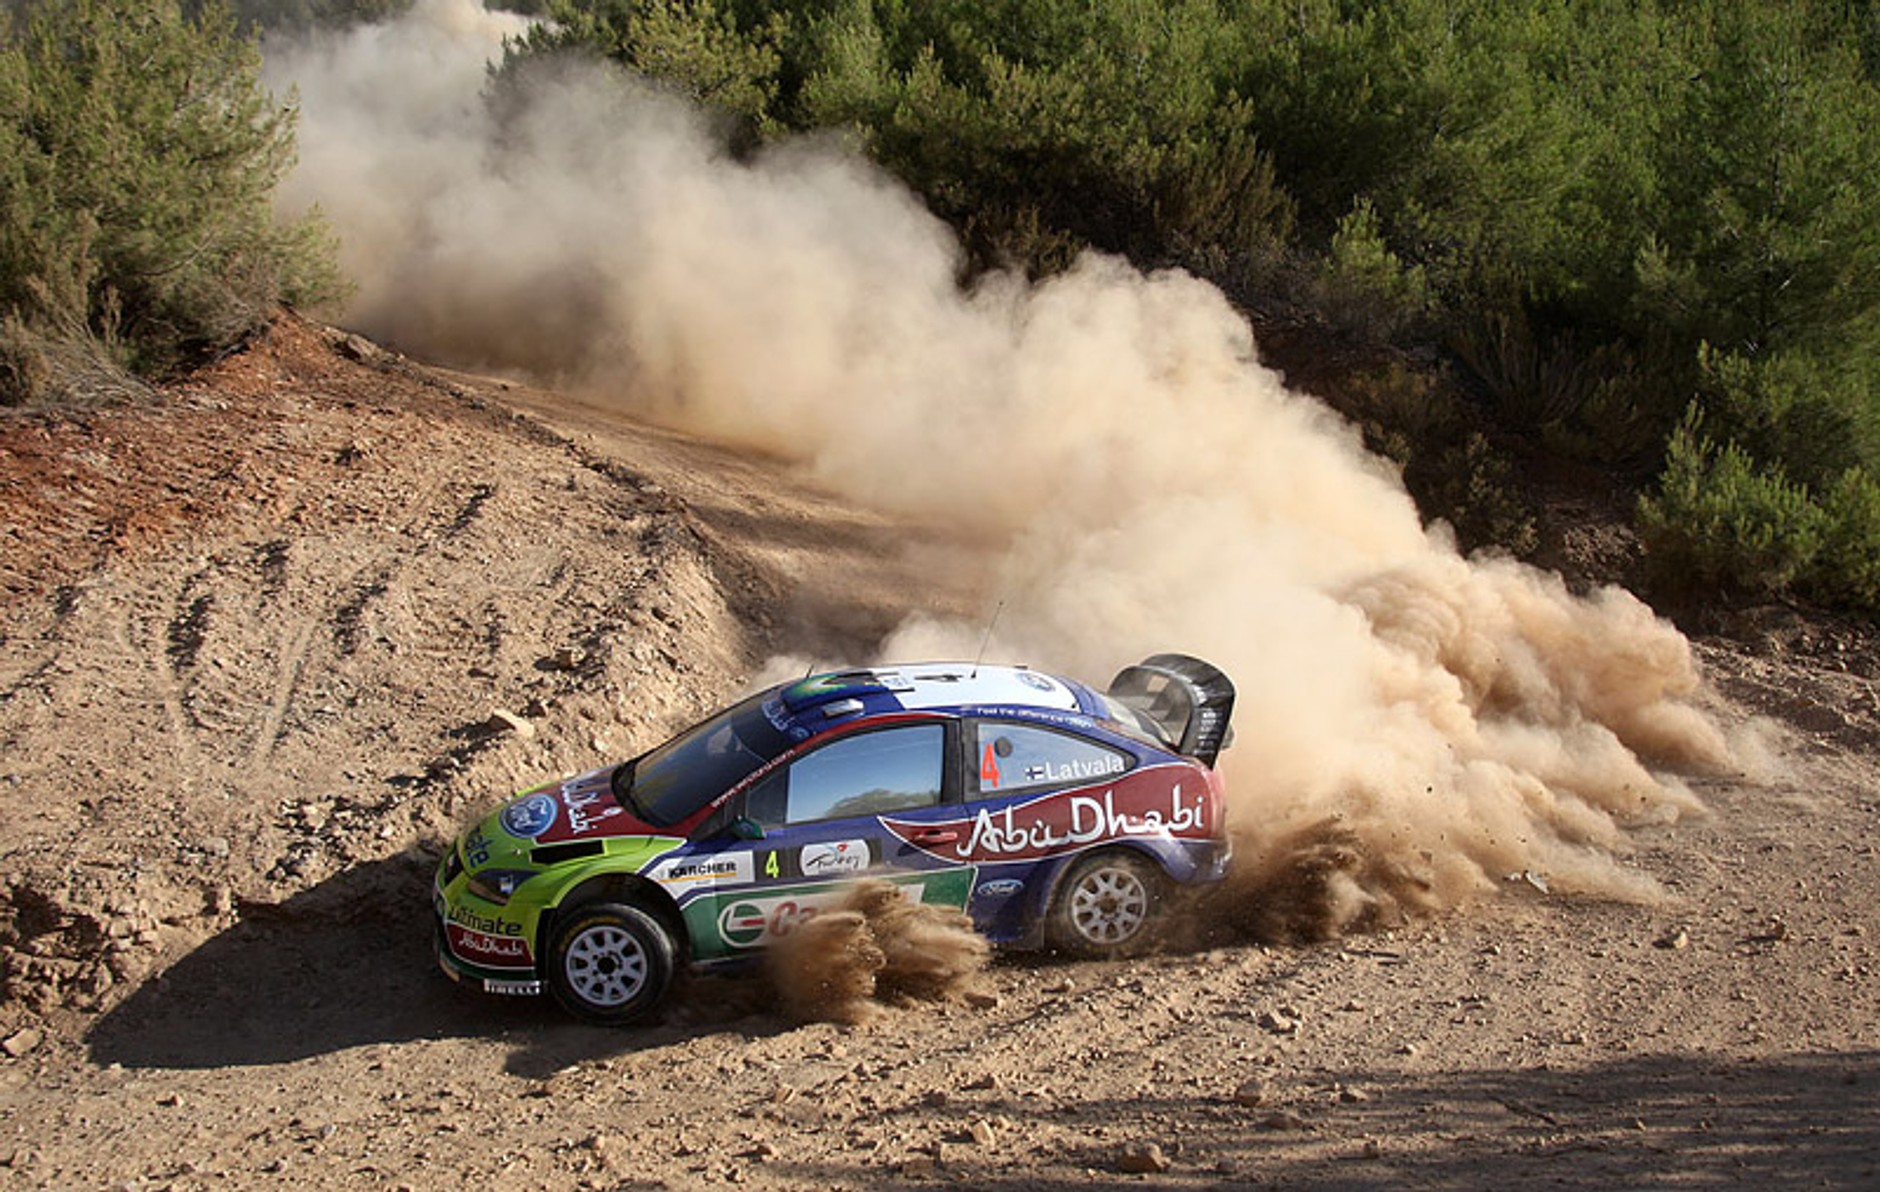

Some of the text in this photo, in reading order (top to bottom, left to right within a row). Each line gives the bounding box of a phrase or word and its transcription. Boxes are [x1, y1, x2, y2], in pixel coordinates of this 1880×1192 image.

[980, 743, 1001, 789] 4
[1045, 755, 1125, 780] Latvala
[956, 783, 1205, 857] Abu Dhabi
[765, 850, 780, 879] 4
